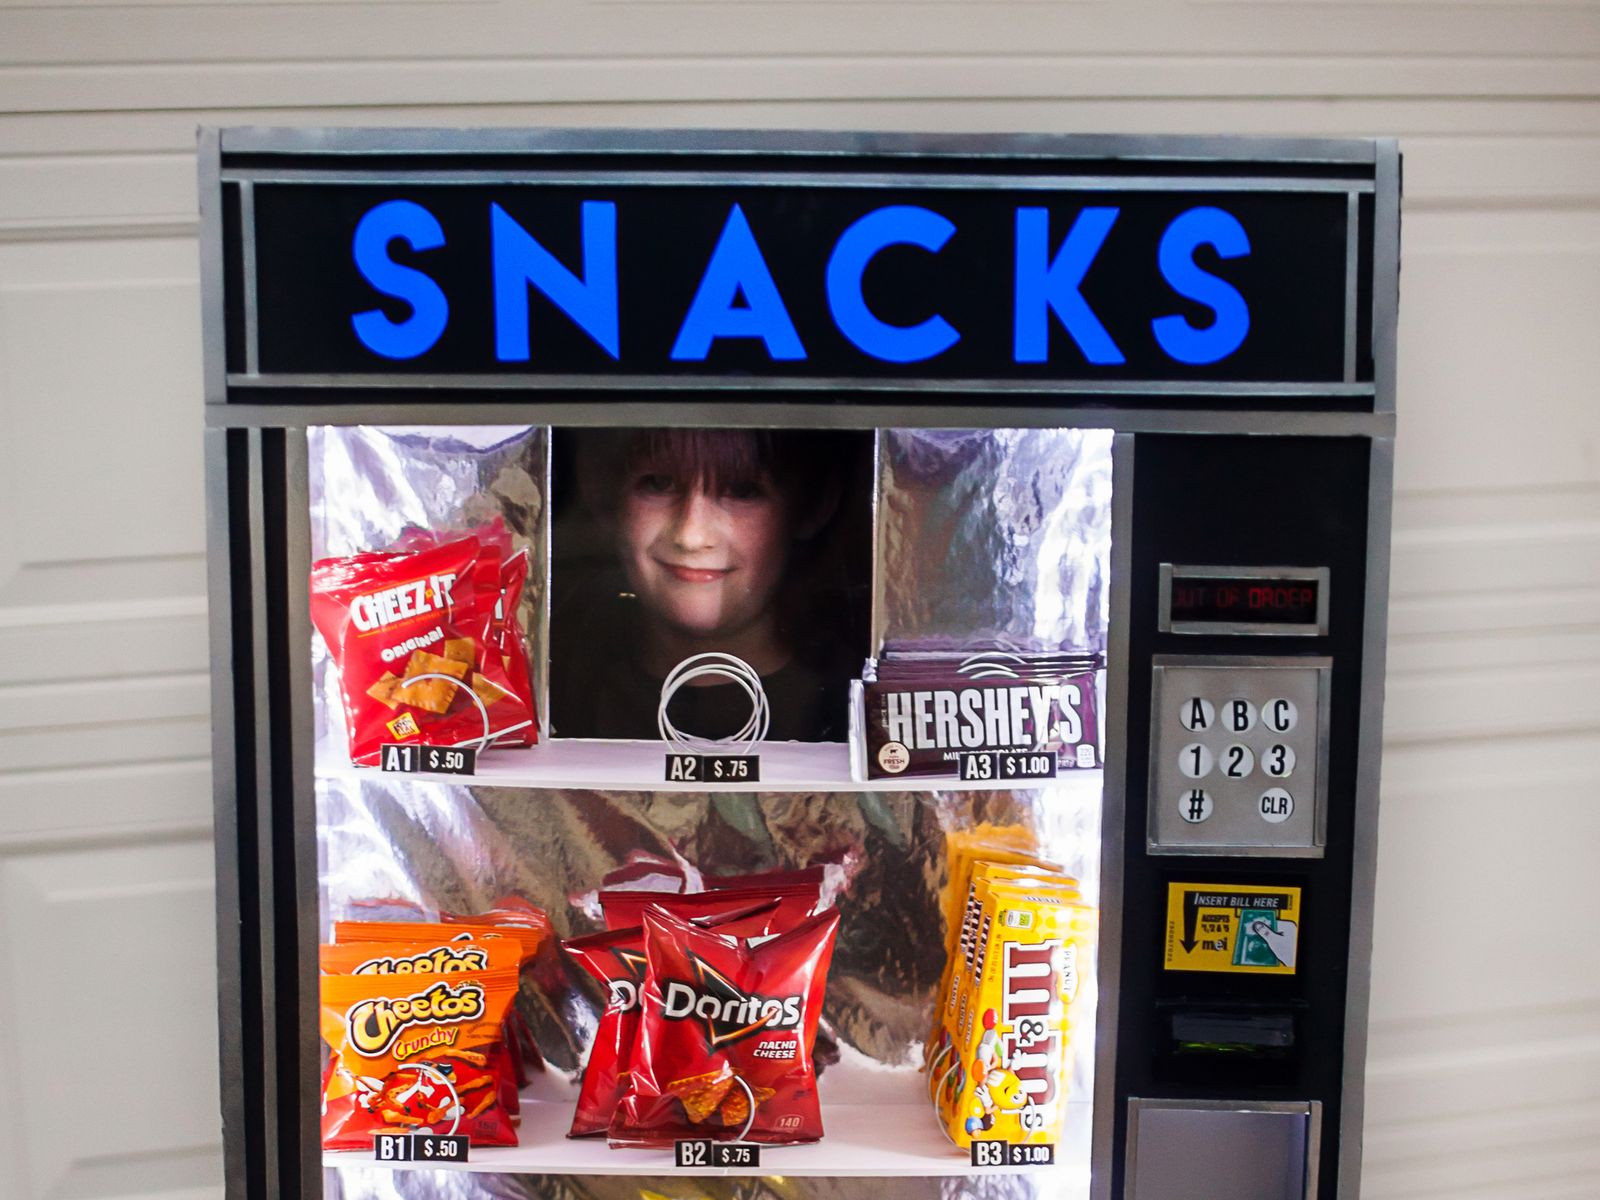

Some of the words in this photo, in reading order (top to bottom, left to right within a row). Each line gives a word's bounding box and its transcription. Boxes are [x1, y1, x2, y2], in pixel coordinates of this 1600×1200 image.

[352, 200, 1251, 364] SNACKS
[1216, 587, 1239, 608] OF
[1248, 587, 1313, 608] ORDER
[887, 684, 1082, 750] HERSHEY'S
[1190, 697, 1207, 729] A
[1233, 701, 1248, 731] B
[1274, 700, 1289, 731] C
[386, 746, 411, 771] A1
[670, 756, 697, 780] A2
[966, 754, 992, 779] A3
[1190, 746, 1201, 775] 1
[1228, 746, 1243, 777] 2
[1270, 744, 1285, 776] 3
[1262, 797, 1288, 815] CLR
[1194, 892, 1228, 907] INSERT
[1230, 897, 1250, 907] BILL
[1253, 898, 1279, 907] HERE
[665, 982, 801, 1028] Doritos
[350, 983, 483, 1052] Cheetos
[753, 1050, 796, 1059] CHEESE
[759, 1041, 797, 1050] NACHO
[381, 1137, 405, 1160] B1
[682, 1142, 706, 1165] B2
[977, 1142, 1002, 1166] B3
